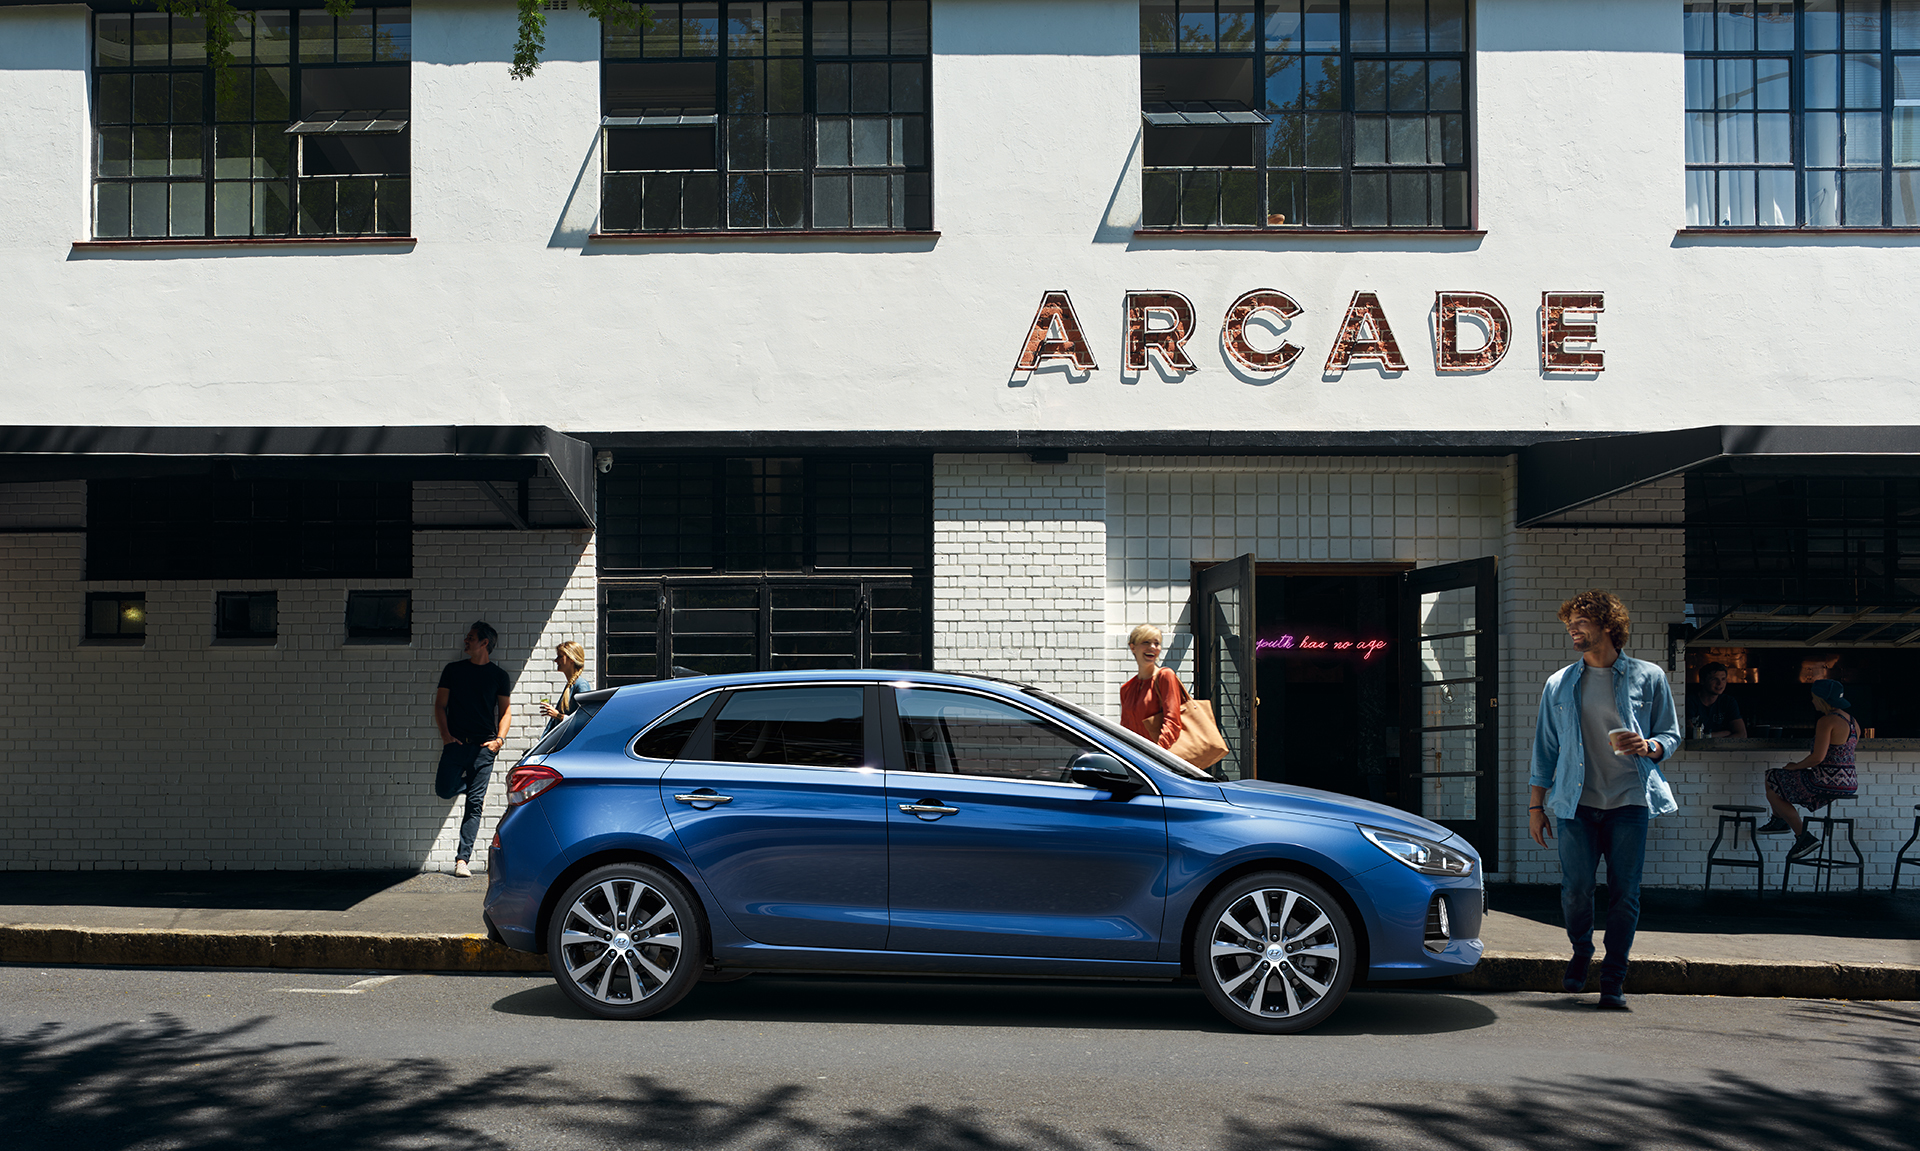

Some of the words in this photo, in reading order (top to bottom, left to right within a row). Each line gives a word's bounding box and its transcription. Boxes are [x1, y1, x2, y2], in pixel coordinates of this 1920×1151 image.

[1014, 288, 1606, 373] ARCADE
[1299, 635, 1328, 649] has
[1333, 640, 1354, 650] no
[1356, 639, 1387, 660] age
